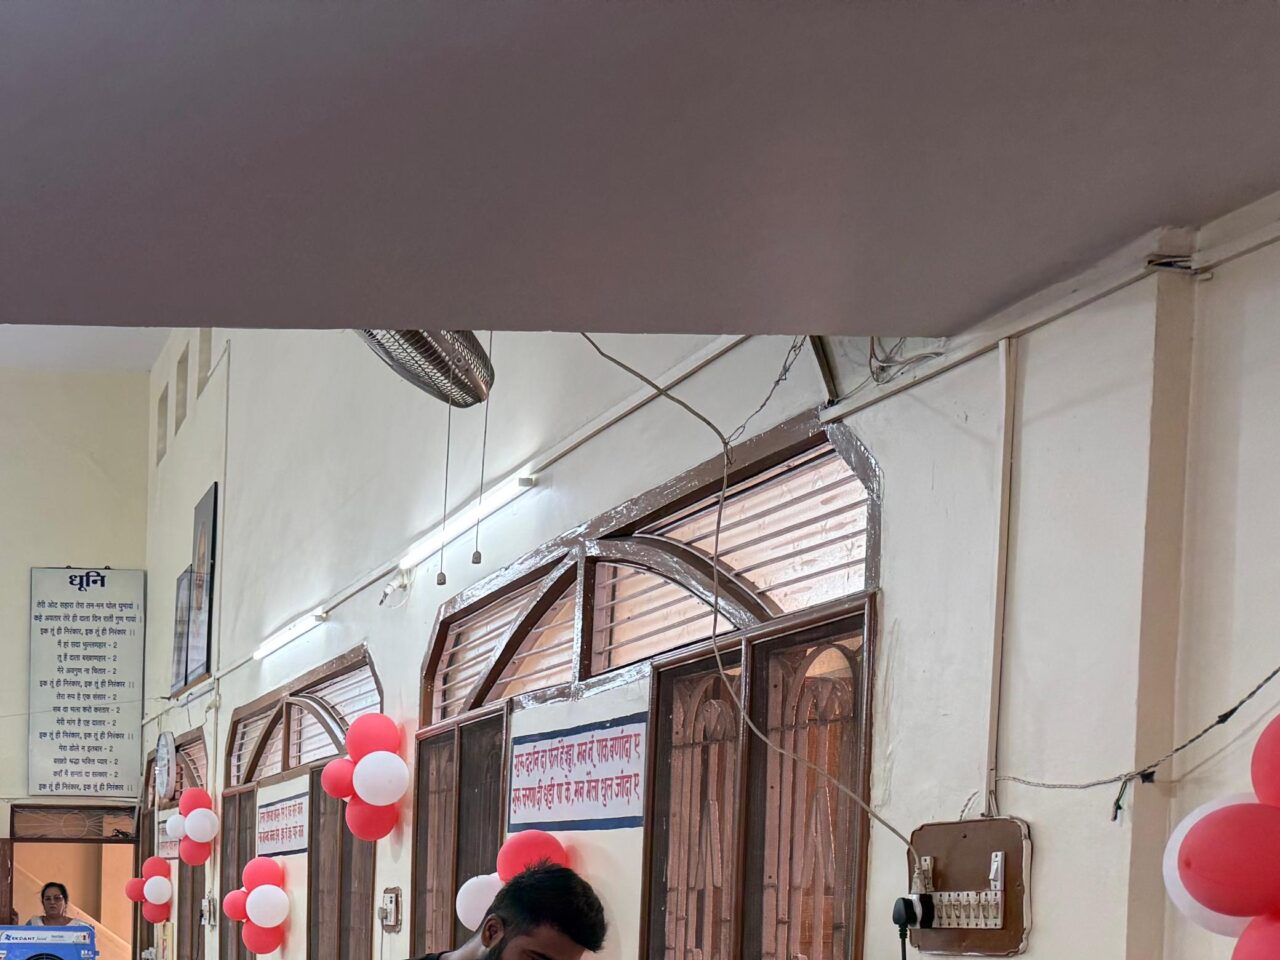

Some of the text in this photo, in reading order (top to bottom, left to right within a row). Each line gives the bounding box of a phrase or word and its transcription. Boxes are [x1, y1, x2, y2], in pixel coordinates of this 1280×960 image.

[68, 571, 106, 591] धूनि
[577, 742, 587, 765] मन
[633, 733, 641, 759] ए
[574, 781, 585, 802] मन
[633, 773, 640, 801] ए
